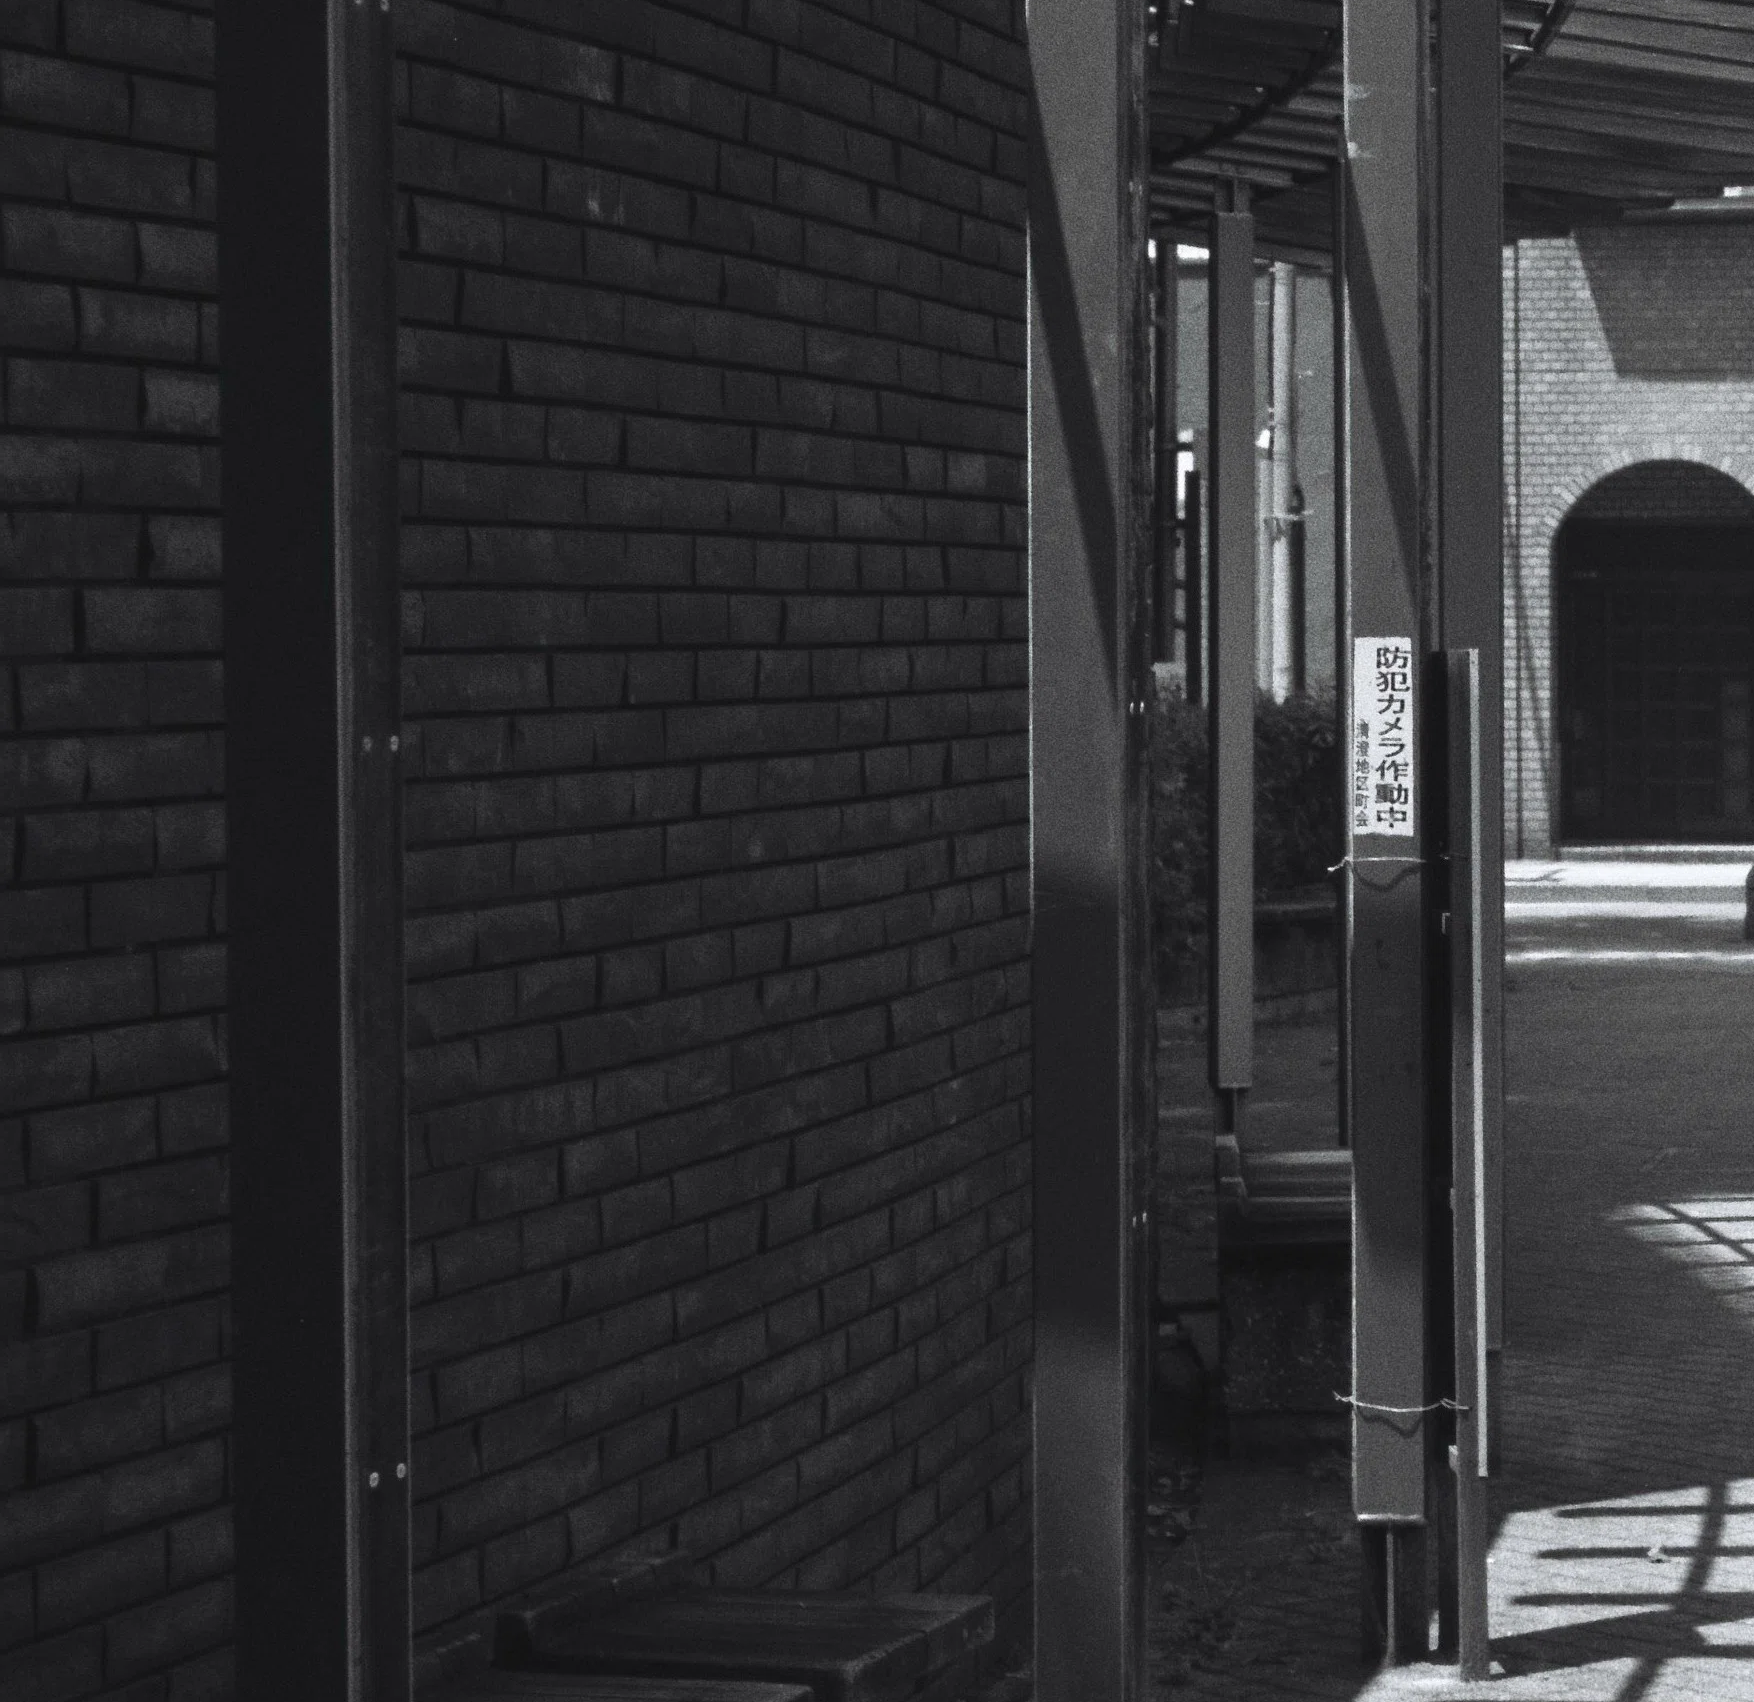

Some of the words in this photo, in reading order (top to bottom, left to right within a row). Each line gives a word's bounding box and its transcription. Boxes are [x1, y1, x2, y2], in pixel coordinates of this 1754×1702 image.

[1374, 646, 1411, 829] 防犯カメラ作動中
